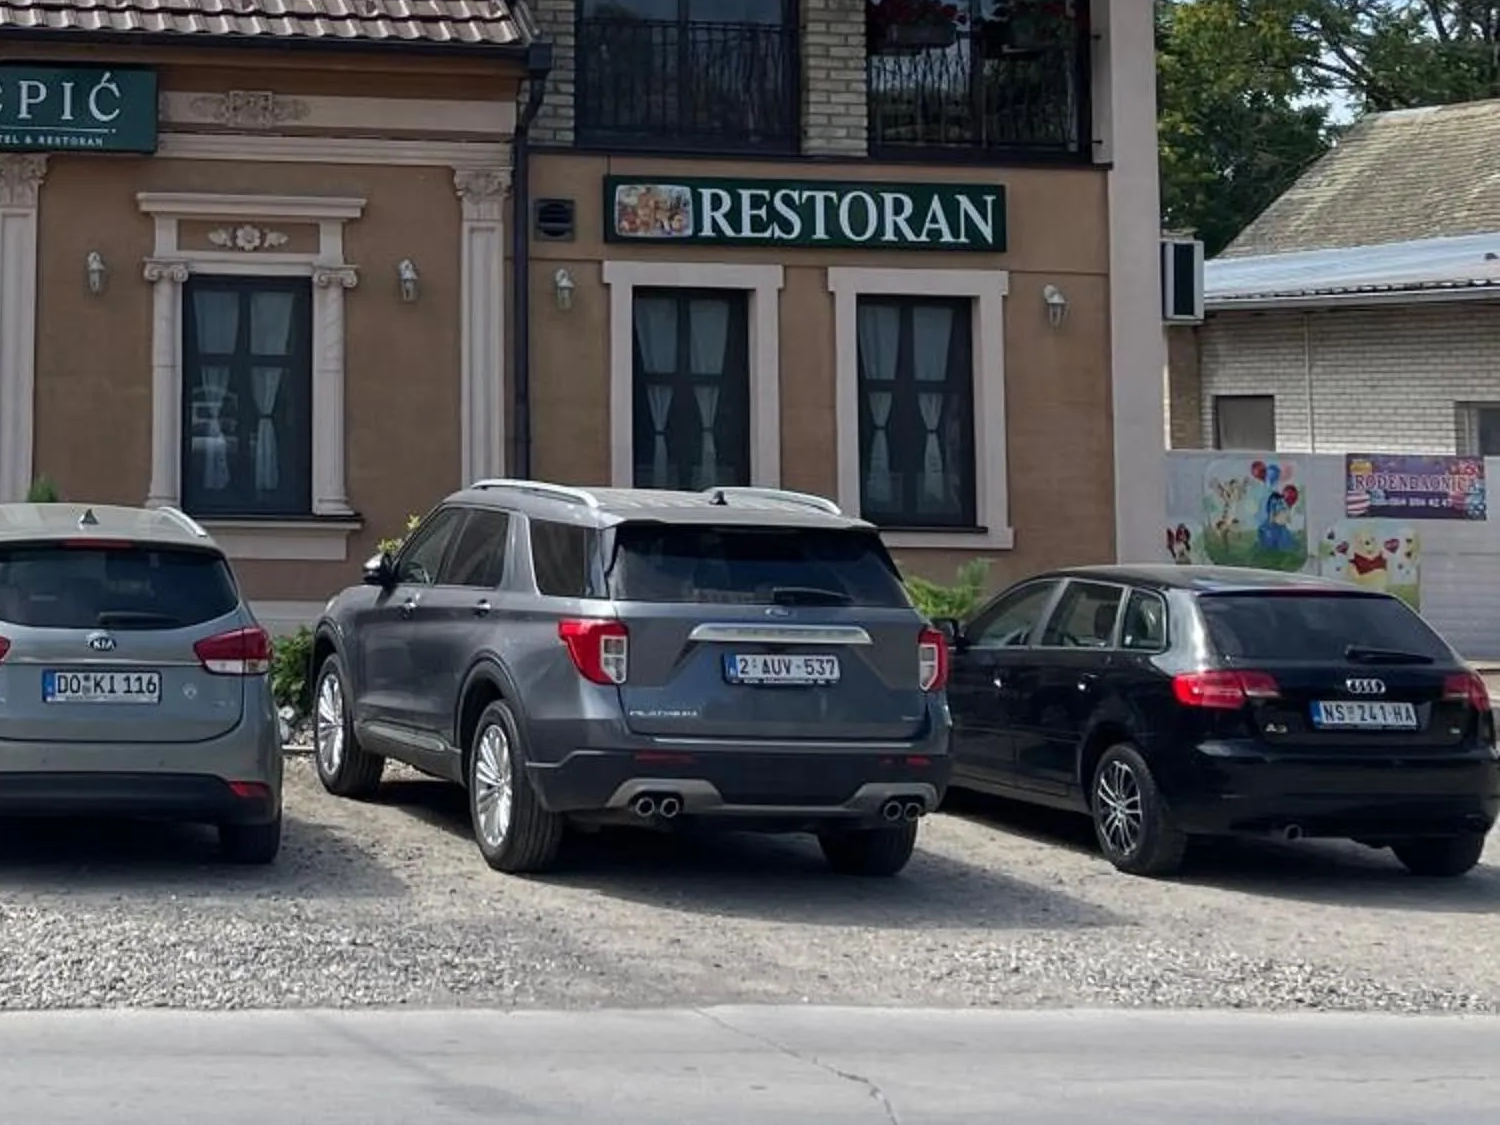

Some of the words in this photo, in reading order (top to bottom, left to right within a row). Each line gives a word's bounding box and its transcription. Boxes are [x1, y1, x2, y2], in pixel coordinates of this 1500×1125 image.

[37, 135, 104, 147] RESTORAN
[697, 187, 997, 244] RESTORAN
[92, 638, 115, 650] KIA
[57, 674, 81, 694] DO
[123, 674, 157, 694] 116
